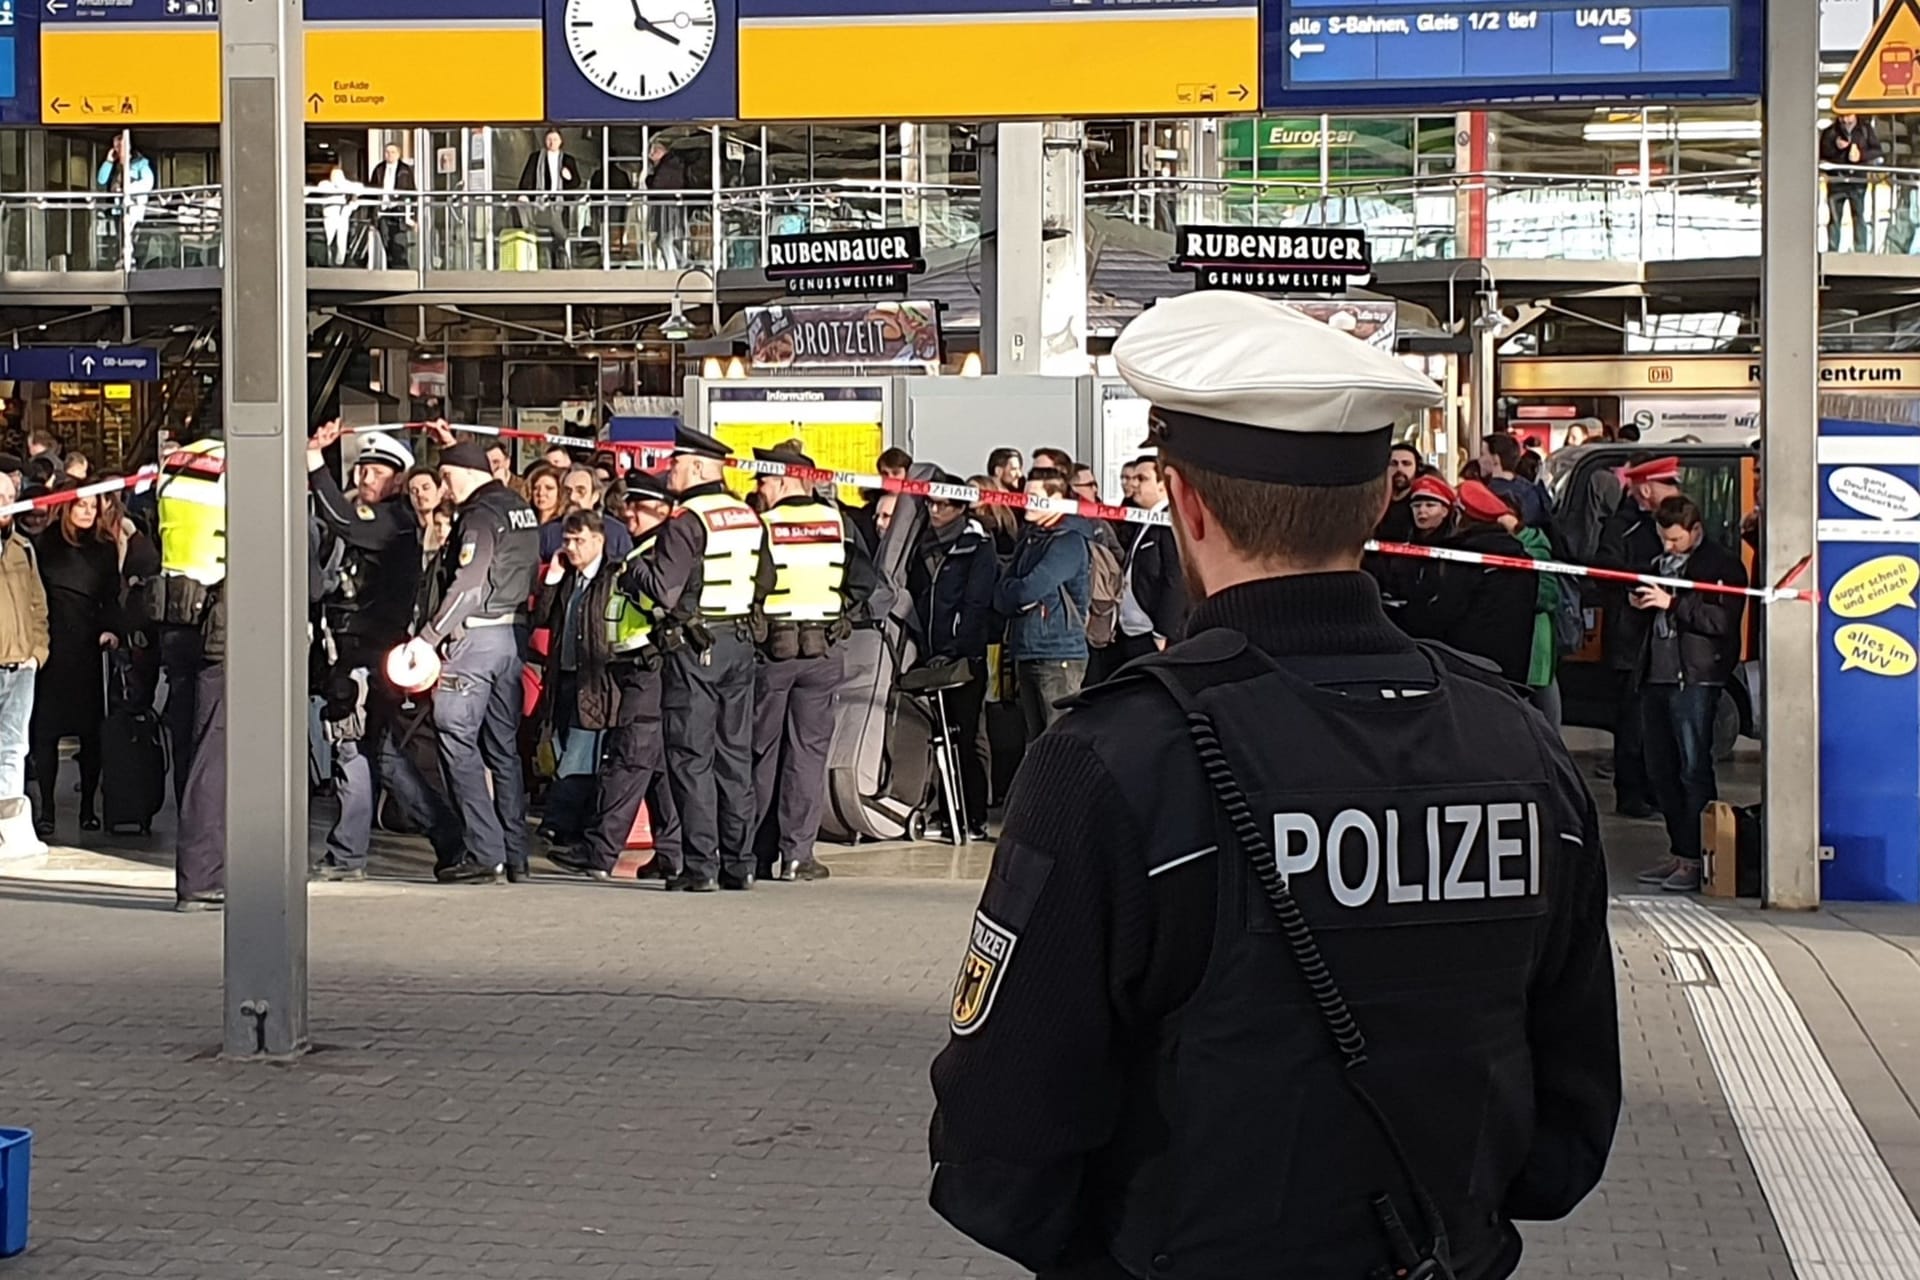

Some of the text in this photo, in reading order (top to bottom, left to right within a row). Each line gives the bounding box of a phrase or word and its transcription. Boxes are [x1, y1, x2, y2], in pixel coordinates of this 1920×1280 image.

[1289, 11, 1538, 35] alle S-Bahnen, Gleis 1/2 tief
[1576, 8, 1632, 27] U4/U5
[334, 80, 369, 90] EurAide
[334, 95, 384, 105] DB Lounge
[789, 274, 894, 291] GENUSSWELTEN
[1208, 272, 1342, 287] GENUSSWELTEN
[794, 320, 886, 355] BROTZEIT
[1014, 334, 1024, 347] B
[766, 390, 825, 401] Information
[1834, 563, 1907, 602] super schnell
[1843, 577, 1908, 610] und einfach
[1847, 631, 1910, 663] alles im
[1851, 646, 1891, 669] MVV
[1273, 803, 1540, 907] POLIZEI
